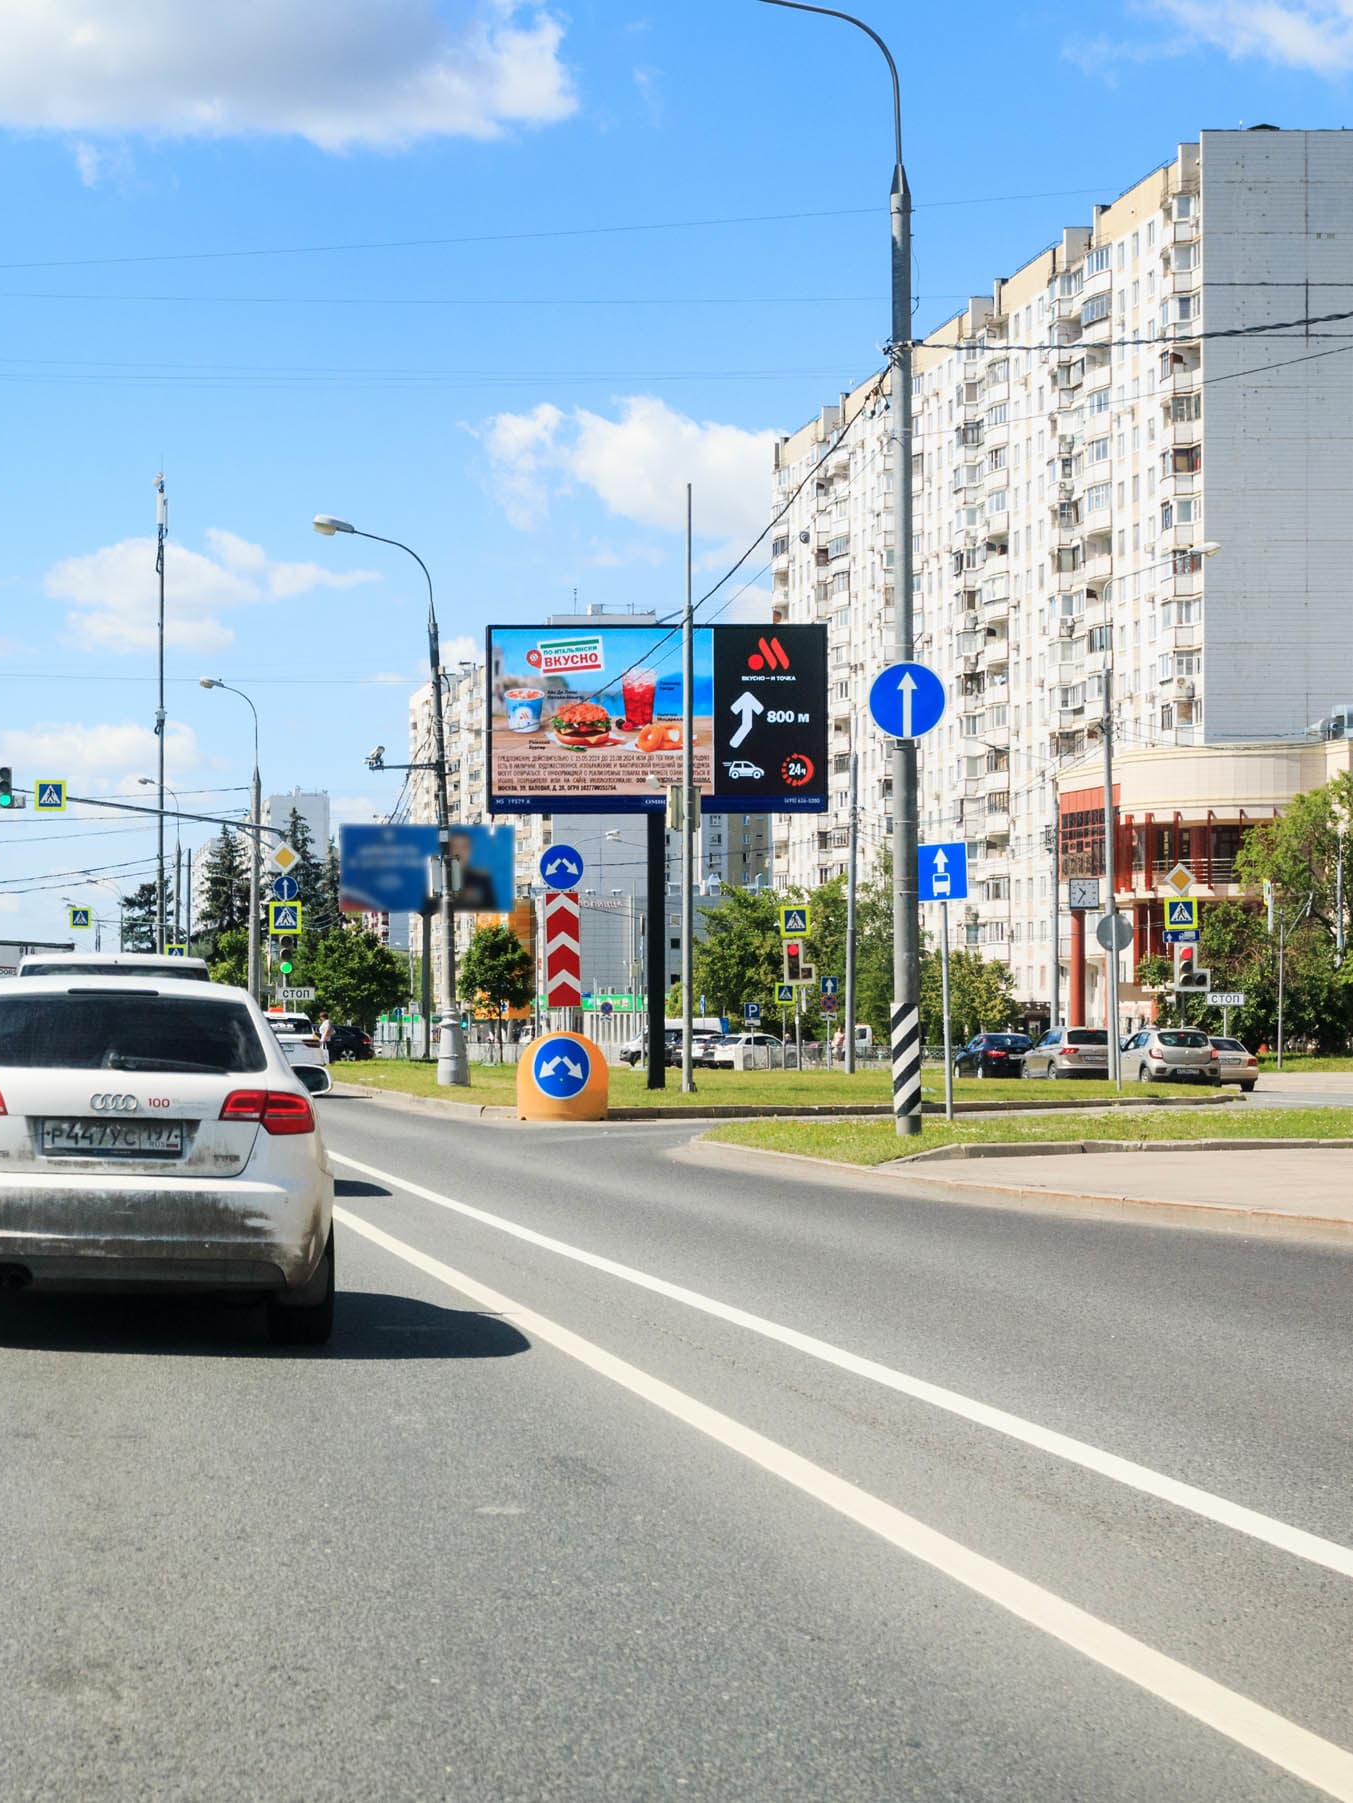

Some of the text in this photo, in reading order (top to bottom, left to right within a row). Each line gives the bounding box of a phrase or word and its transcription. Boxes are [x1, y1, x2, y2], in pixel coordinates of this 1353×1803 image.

[544, 652, 599, 668] ВКУСНО
[766, 710, 795, 723] 800
[282, 990, 310, 998] СТОП
[1211, 994, 1240, 1004] СТОП
[148, 1098, 170, 1108] 100
